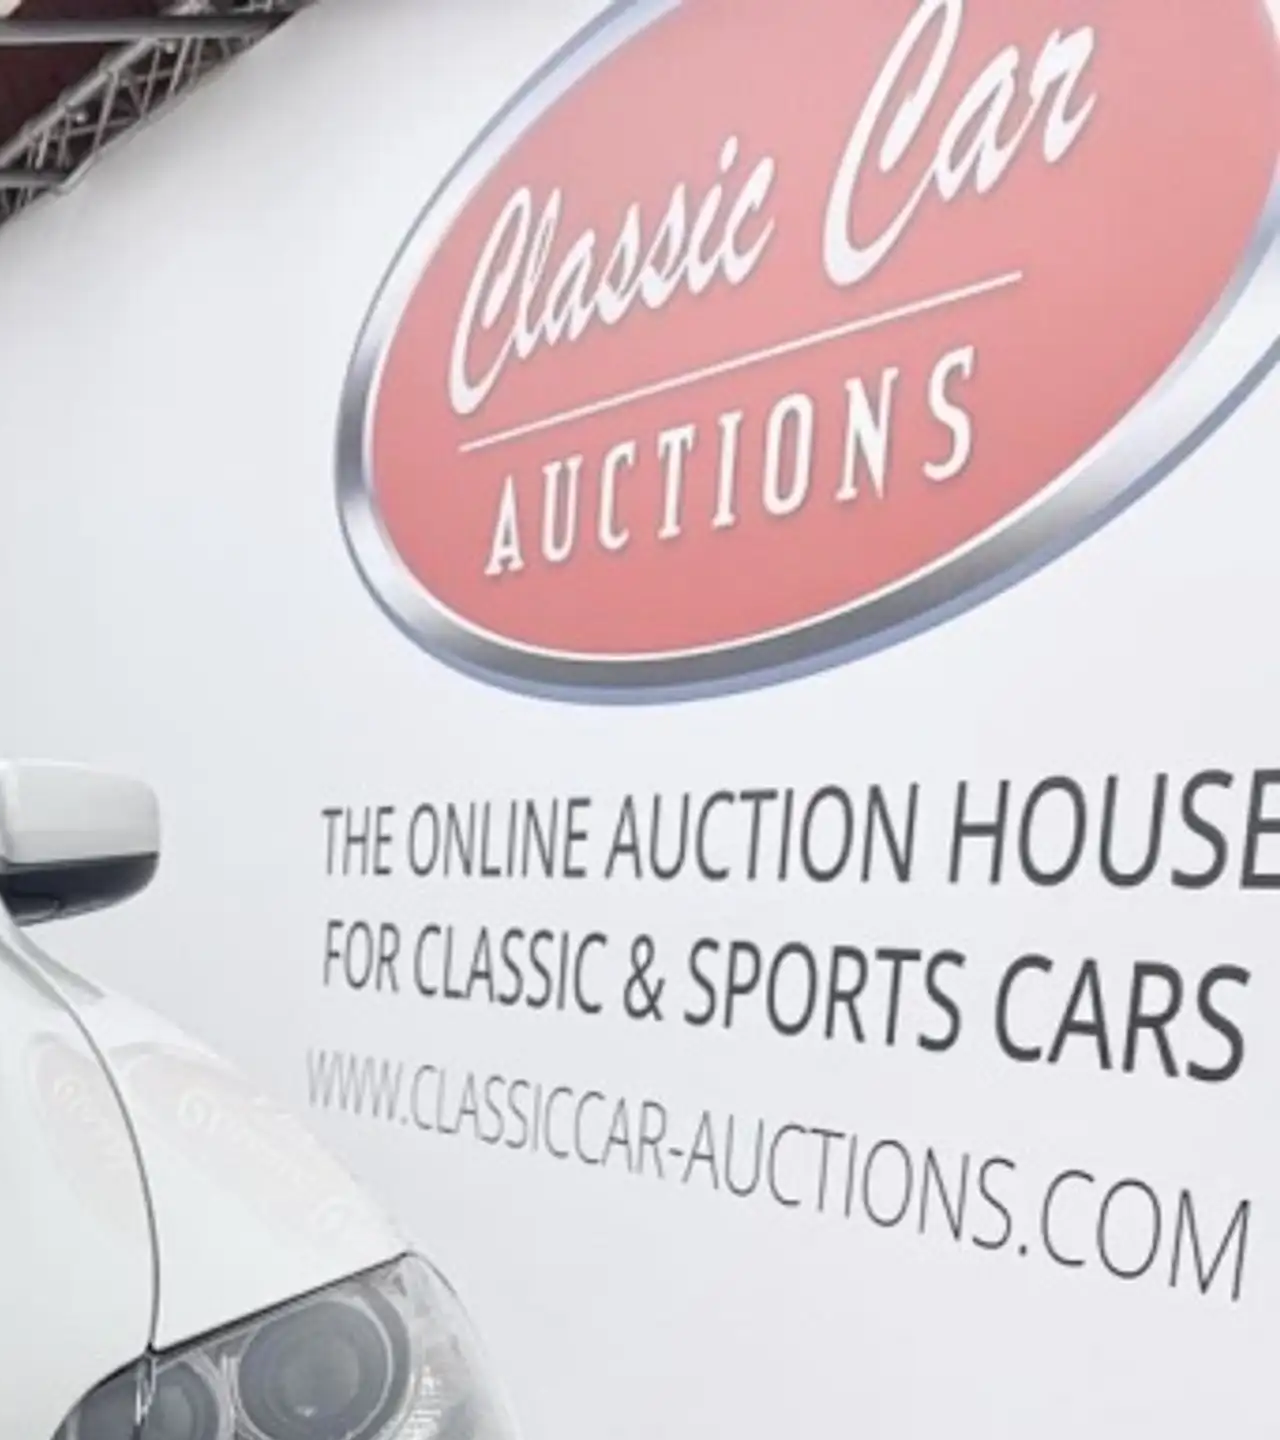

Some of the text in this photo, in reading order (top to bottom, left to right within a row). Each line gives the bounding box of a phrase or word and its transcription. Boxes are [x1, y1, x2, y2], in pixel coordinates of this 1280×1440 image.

[448, 0, 1097, 415] Classic Car
[483, 346, 975, 576] AUCTIONS
[321, 768, 1280, 890] THE ONLINE AUCTION HOUSE
[322, 920, 1252, 1083] FOR CLASSIC & SPORTS CARS
[306, 1048, 1252, 1302] WWW.CLASSICCAR-AUCTIONS.COM
